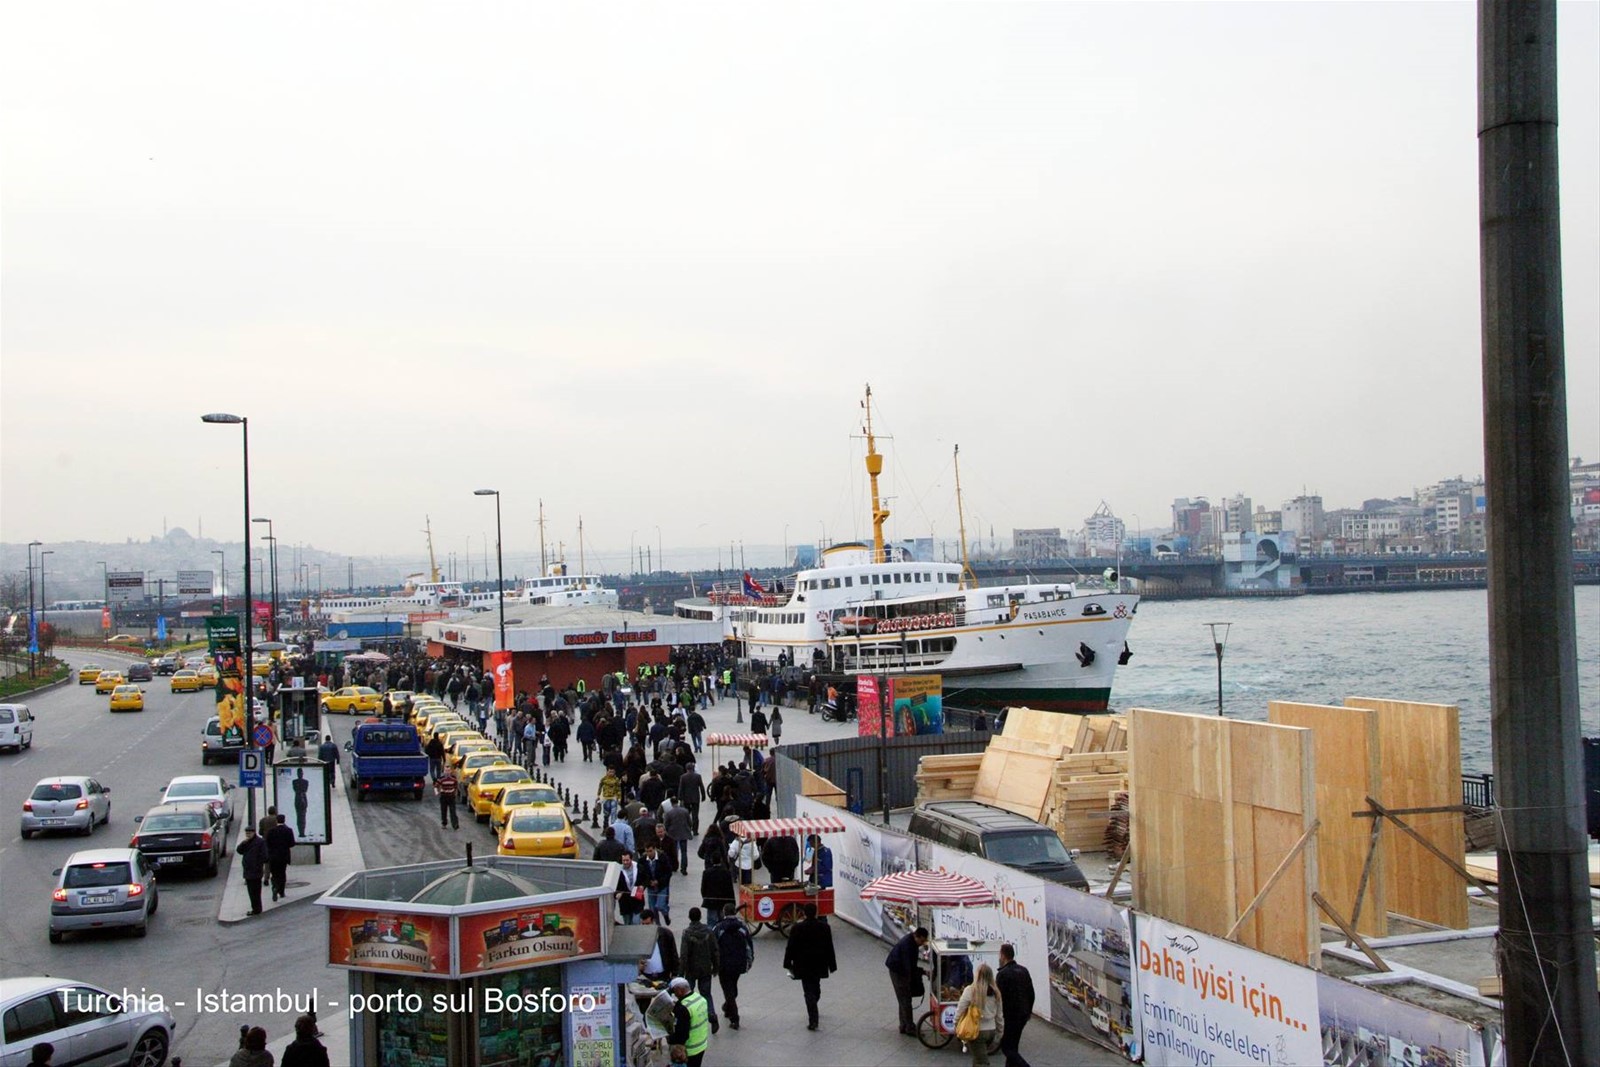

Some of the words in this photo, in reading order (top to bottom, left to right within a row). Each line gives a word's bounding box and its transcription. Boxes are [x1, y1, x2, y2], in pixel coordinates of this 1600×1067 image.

[564, 631, 609, 645] KADIKÖY
[246, 754, 257, 769] D
[391, 949, 427, 965] Olsun!
[489, 945, 529, 963] Farkın
[533, 941, 573, 952] Olsun!
[1140, 940, 1185, 985] Daha
[1191, 958, 1234, 1003] iyisi
[1241, 976, 1307, 1031] için...
[1143, 994, 1199, 1034] Eminönü
[1203, 1014, 1271, 1066] İskeleleri
